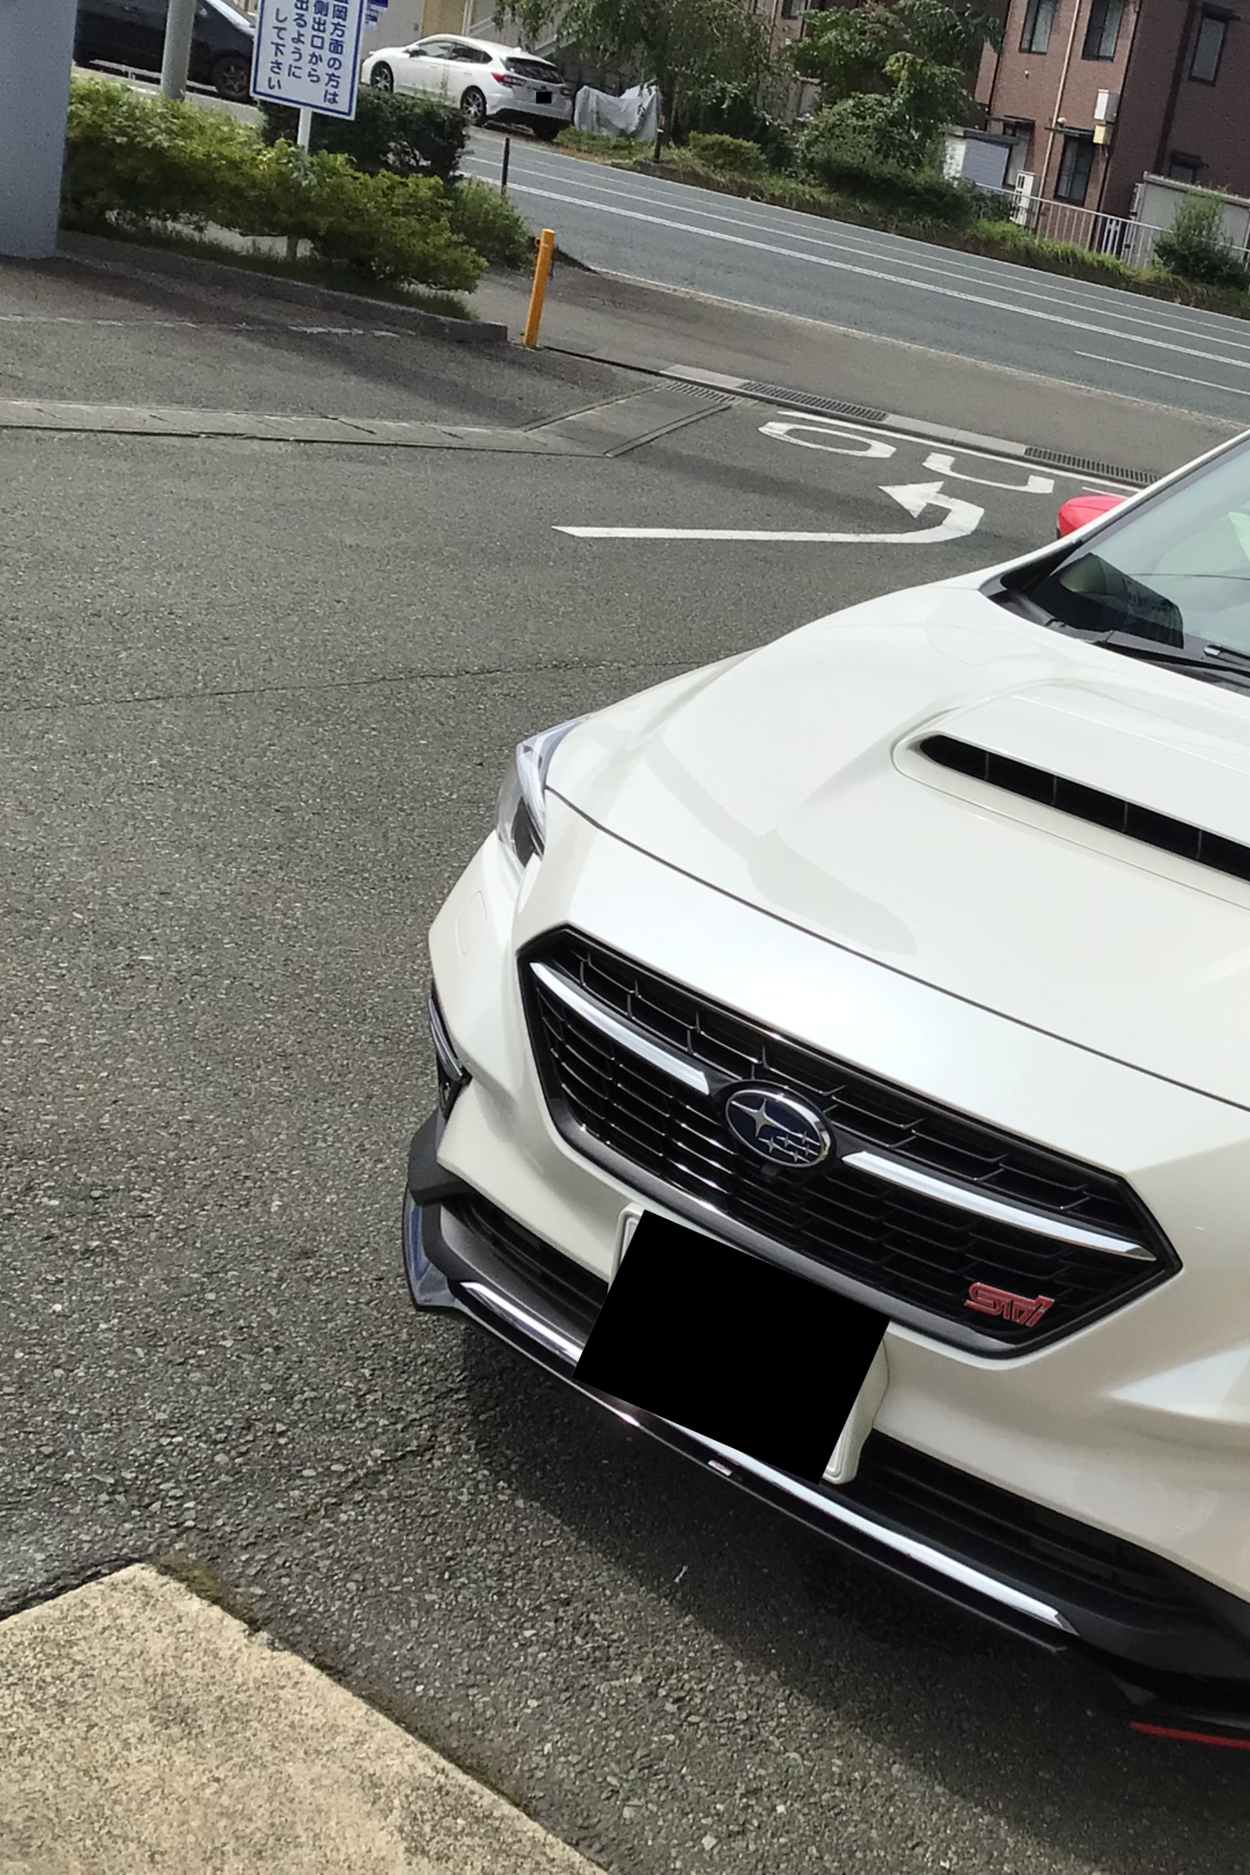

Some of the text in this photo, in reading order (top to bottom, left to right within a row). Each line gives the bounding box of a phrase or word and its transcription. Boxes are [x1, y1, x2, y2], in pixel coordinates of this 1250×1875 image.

[268, 8, 288, 90] して下さい
